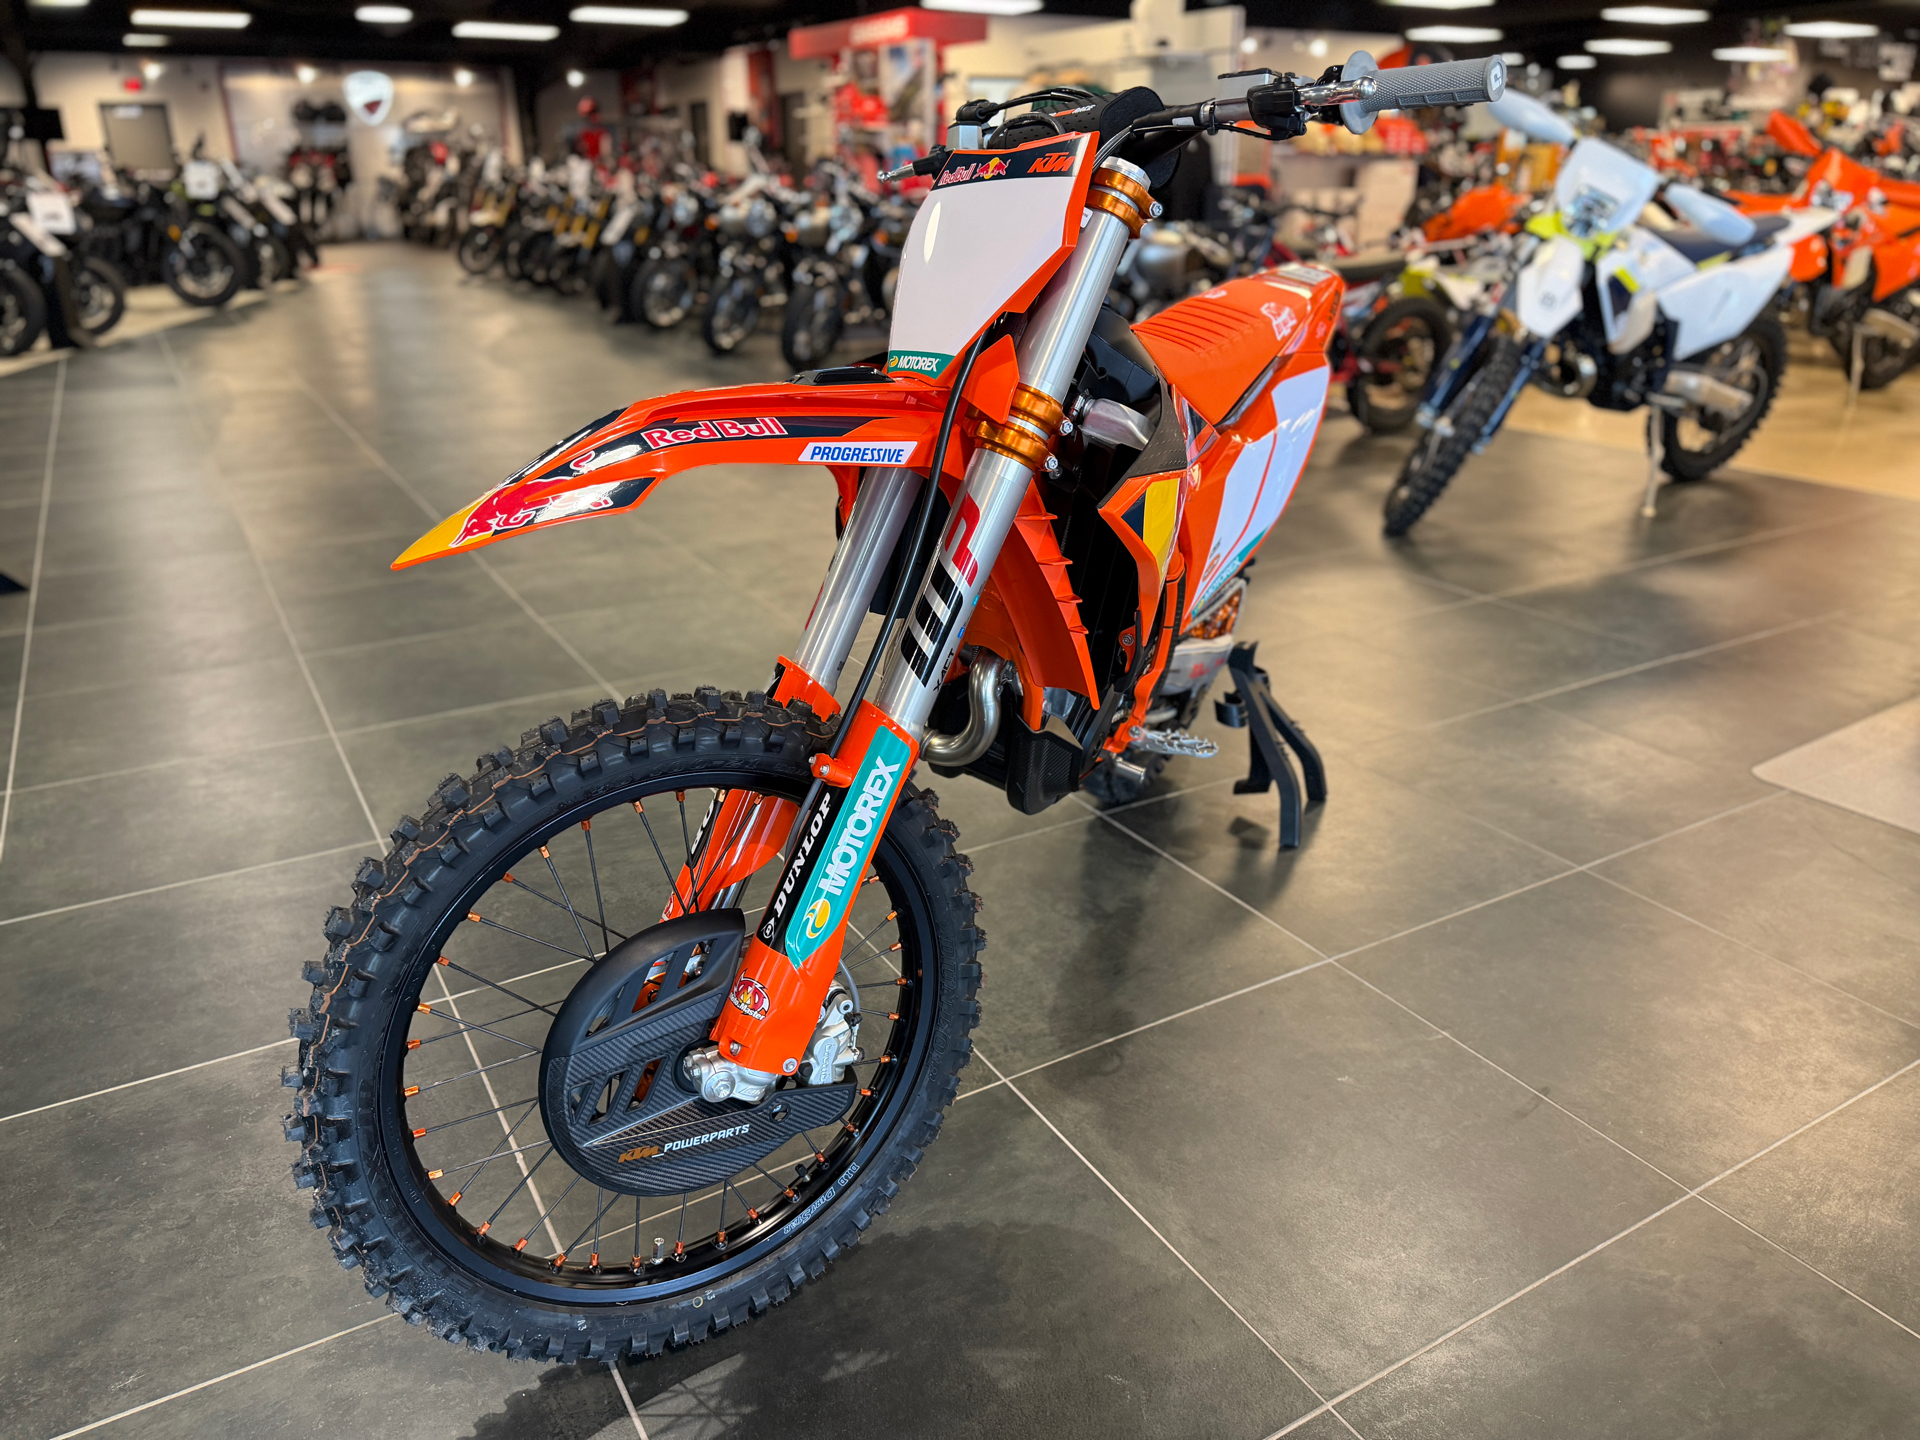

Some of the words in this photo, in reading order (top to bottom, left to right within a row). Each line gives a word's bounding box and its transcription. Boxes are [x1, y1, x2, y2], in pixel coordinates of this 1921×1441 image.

[1026, 152, 1076, 173] KTM
[897, 354, 938, 373] MOTOREX
[809, 445, 905, 465] PROGRESSIVE
[818, 756, 901, 897] MOTOREX
[773, 792, 832, 919] DUNLOP
